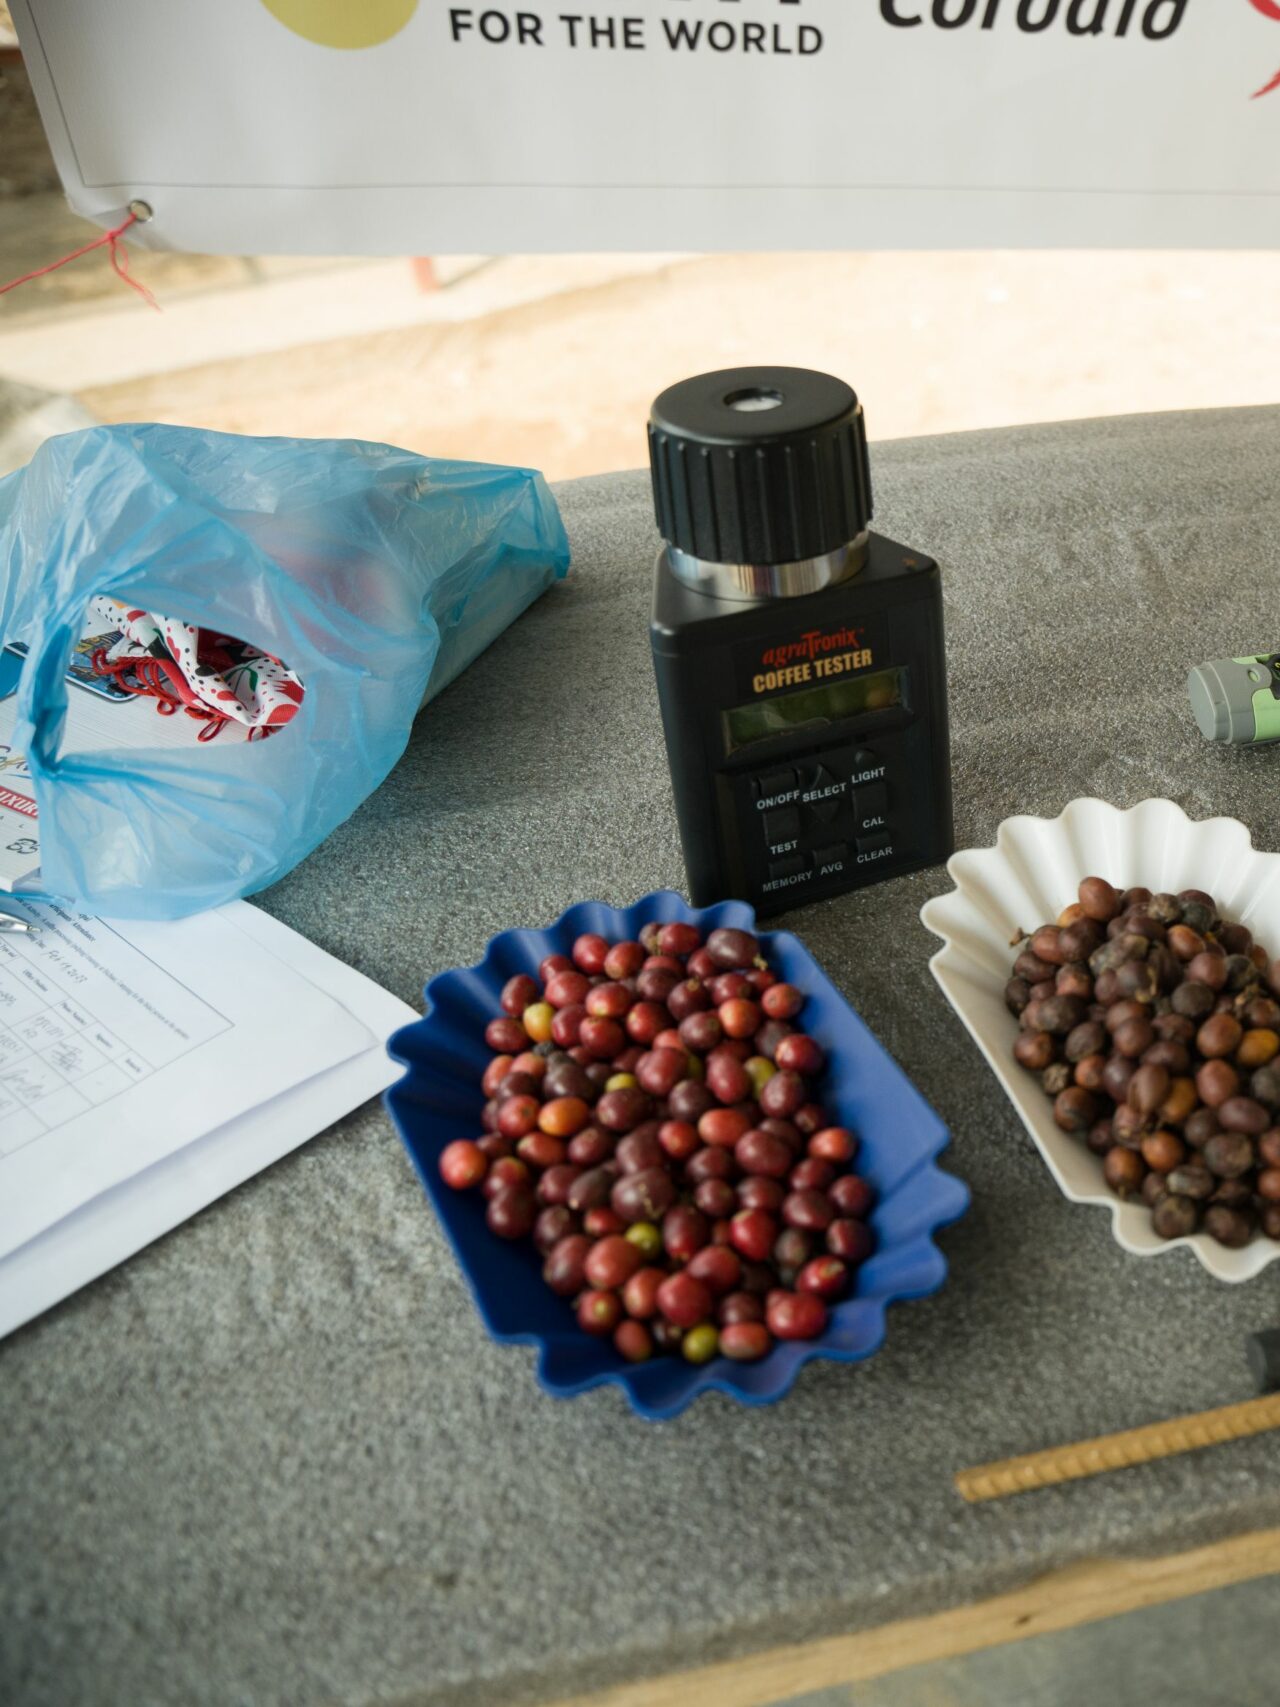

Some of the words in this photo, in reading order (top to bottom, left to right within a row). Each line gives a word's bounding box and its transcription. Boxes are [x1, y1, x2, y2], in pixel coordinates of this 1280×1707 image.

[449, 9, 544, 46] FOR
[559, 15, 646, 50] THE
[661, 18, 823, 56] WORLD
[753, 662, 812, 693] COFFEE
[814, 648, 872, 678] TESTER
[756, 789, 800, 810] ON/OFF
[802, 782, 847, 803] SELECT
[851, 766, 885, 784] LIGHT
[862, 816, 884, 828] CAL
[770, 839, 798, 855] TEST
[856, 846, 893, 864] CLEAR
[762, 870, 812, 893] MEMORY
[820, 860, 843, 876] AVG
